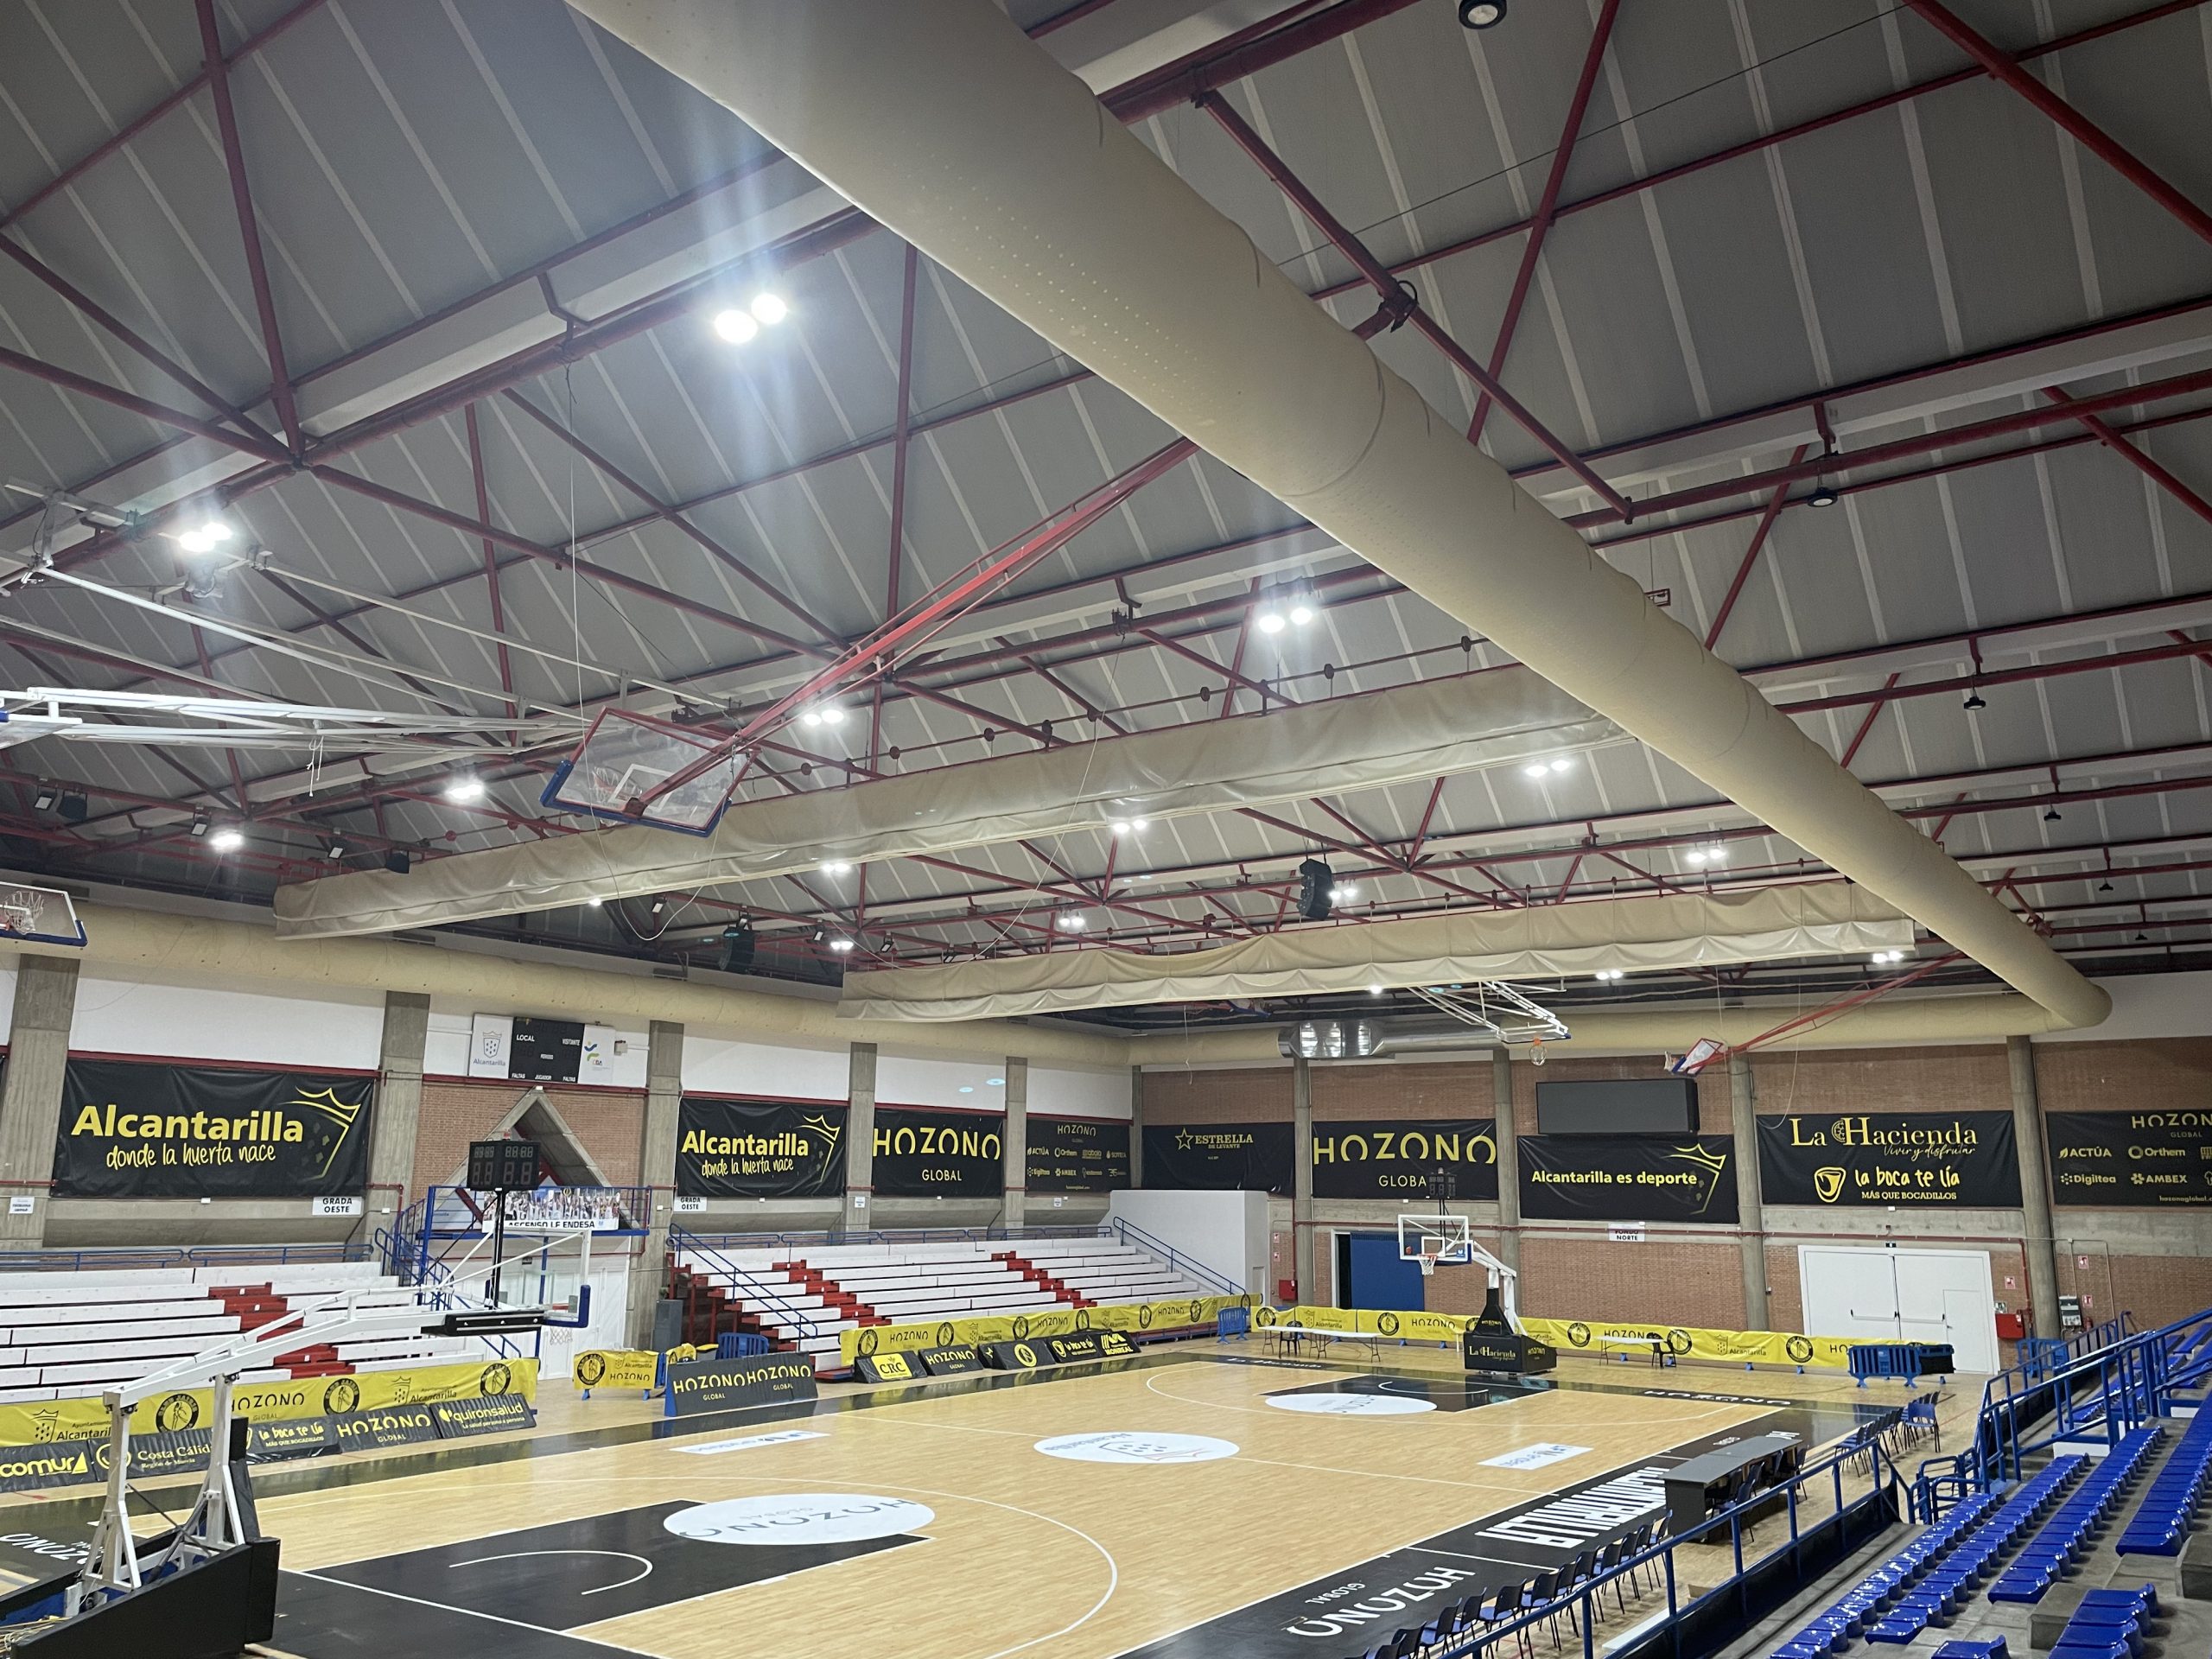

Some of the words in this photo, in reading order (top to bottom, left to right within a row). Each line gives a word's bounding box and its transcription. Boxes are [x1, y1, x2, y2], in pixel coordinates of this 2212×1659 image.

[517, 1033, 536, 1042] LOCAL
[71, 1104, 303, 1142] Alcantarilla
[1057, 1124, 1096, 1137] HOZONO
[1789, 1117, 1827, 1147] La
[1840, 1116, 1979, 1147] Hacienda
[681, 1129, 809, 1156] Alcantarilla
[872, 1127, 1001, 1160] HOZONO
[1194, 1134, 1253, 1144] ESTRELLA
[1313, 1132, 1497, 1165] HOZONO
[2070, 1146, 2112, 1157] ACTÚA
[2145, 1147, 2186, 1156] Orthem
[106, 1142, 156, 1171] donde
[162, 1143, 178, 1166] la
[183, 1140, 233, 1166] huerta
[238, 1143, 276, 1163] nace
[702, 1158, 728, 1179] donde
[731, 1158, 741, 1175] la
[742, 1156, 771, 1175] huerta
[772, 1158, 794, 1172] nace
[921, 1169, 963, 1180] GLOBAL
[1379, 1175, 1427, 1187] GLOBA
[1531, 1170, 1612, 1184] Alcantarilla
[1617, 1173, 1633, 1184] es
[1637, 1172, 1697, 1187] deporte
[1855, 1168, 1870, 1187] la
[1876, 1166, 1910, 1186] boca
[1915, 1169, 1934, 1187] te
[1940, 1166, 1960, 1187] lía
[2074, 1174, 2117, 1185] Digiltea
[2146, 1175, 2188, 1184] AMBEX
[1861, 1190, 1880, 1199] MÁS
[1882, 1192, 1901, 1200] QUE
[1901, 1191, 1957, 1200] BOCADILLOS
[1412, 1319, 1455, 1330] HOZONO
[890, 1331, 929, 1344] HOZONO
[1604, 1330, 1644, 1339] HOZON
[925, 1348, 976, 1366] HOZONO
[1729, 1348, 1767, 1357] Alcantarilla
[747, 1365, 811, 1383] HOZONO
[880, 1362, 906, 1374] CRC
[610, 1372, 650, 1381] HOZONO
[673, 1373, 746, 1395] HOZONO
[772, 1382, 793, 1391] GLOBAL
[410, 1389, 457, 1403] Alcantarilla
[702, 1393, 726, 1402] GLOBAL
[337, 1414, 430, 1438] HOZONO
[259, 1431, 270, 1441] la
[377, 1434, 406, 1443] GLOBAL
[138, 1451, 175, 1460] Costa
[176, 1444, 213, 1457] Cálid
[679, 1499, 918, 1538] HOZONO
[1305, 1583, 1366, 1605] GLOBAL
[1286, 1567, 1476, 1637] HOZONO
